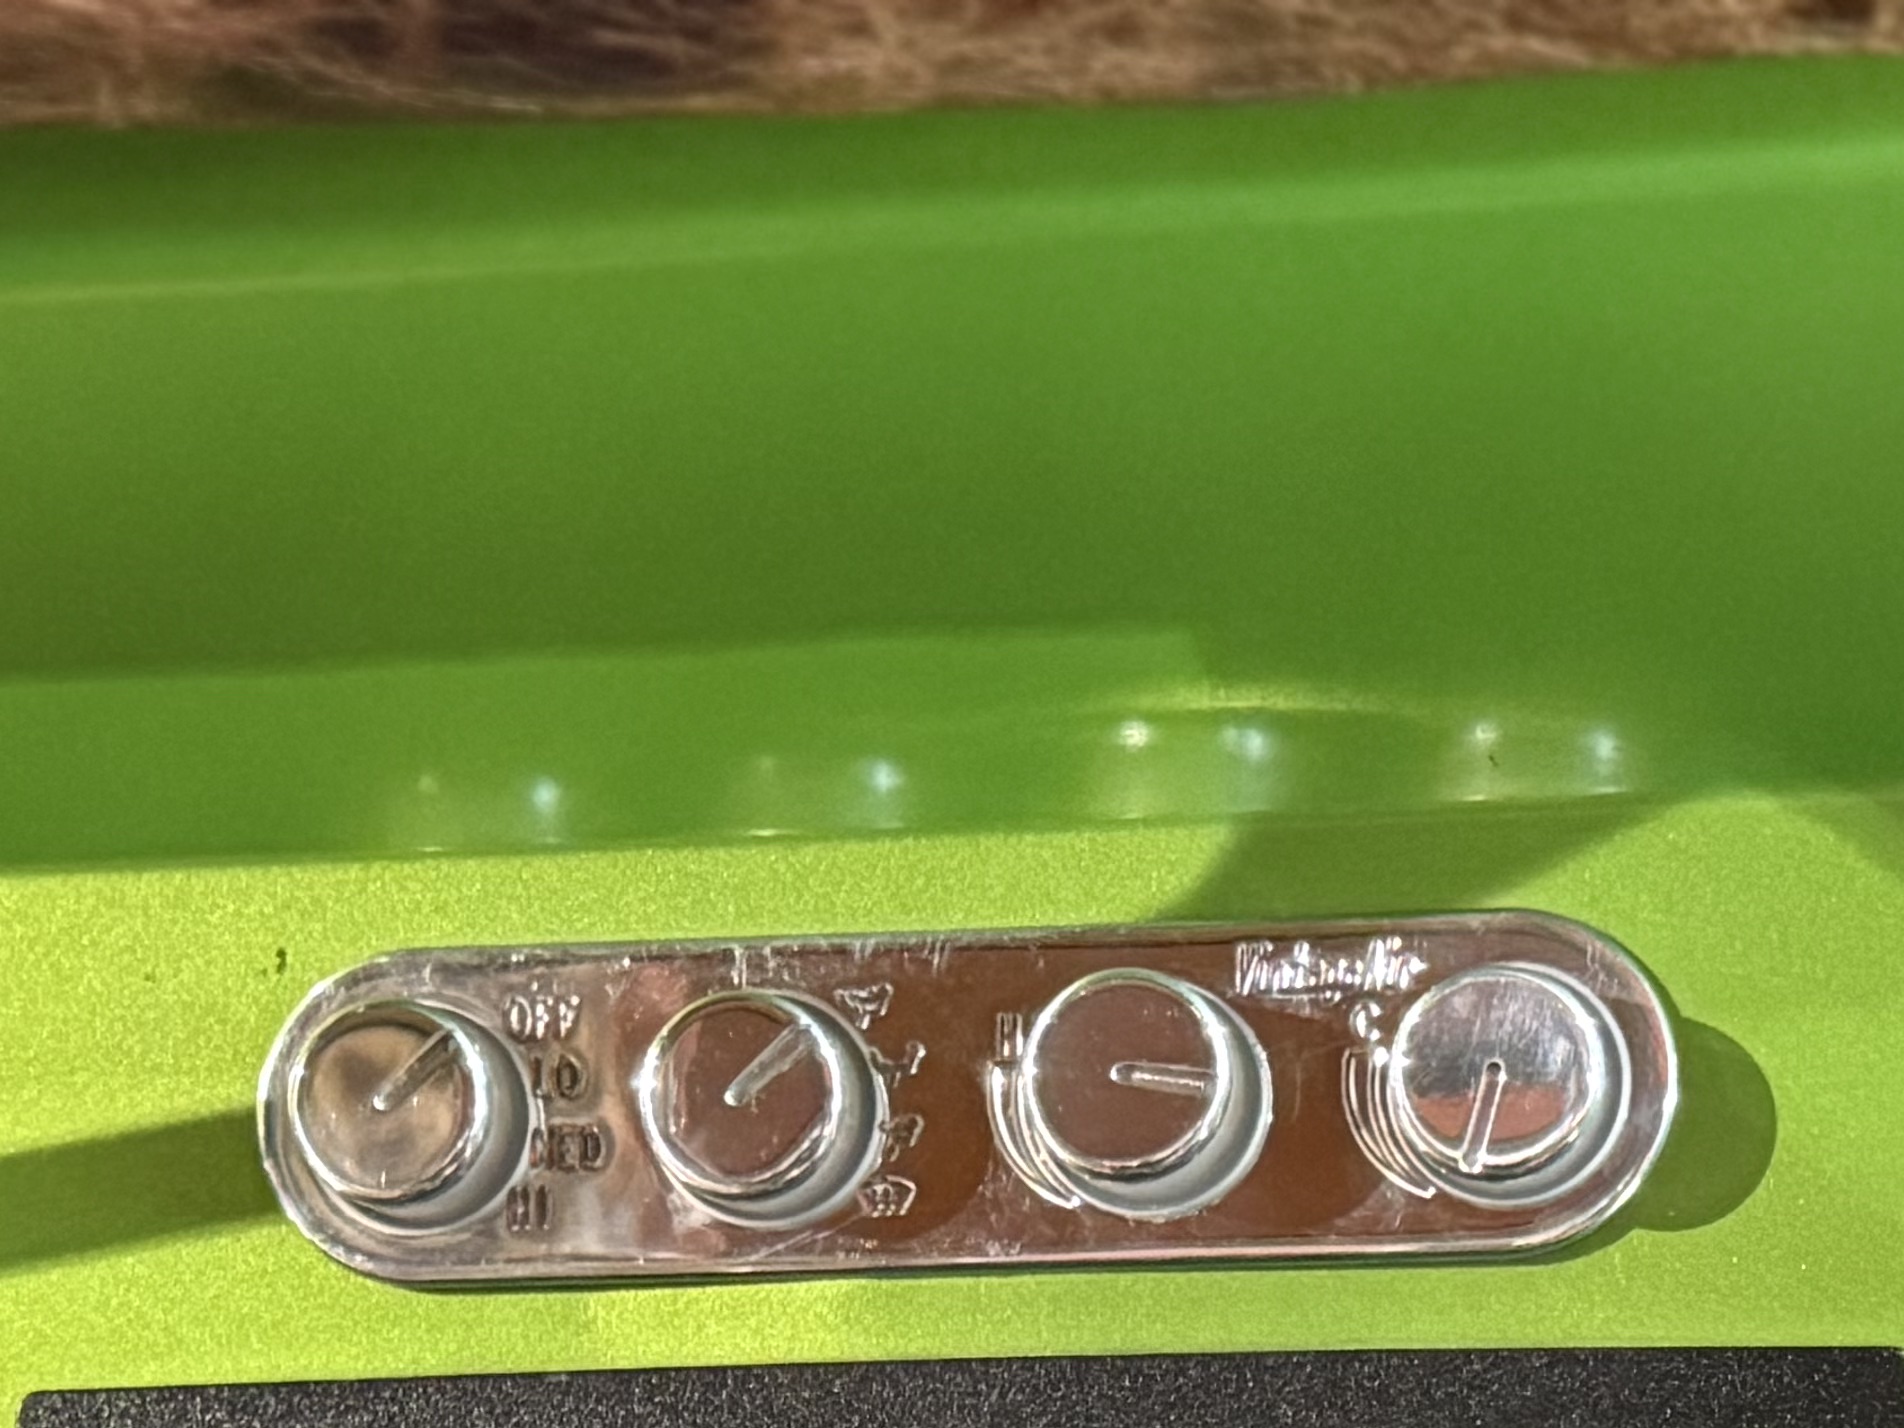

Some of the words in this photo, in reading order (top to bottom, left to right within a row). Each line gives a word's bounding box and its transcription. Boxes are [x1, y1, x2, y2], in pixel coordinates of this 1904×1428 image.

[503, 994, 581, 1043] OFF
[1349, 1000, 1383, 1041] C
[506, 1183, 551, 1232] HI
